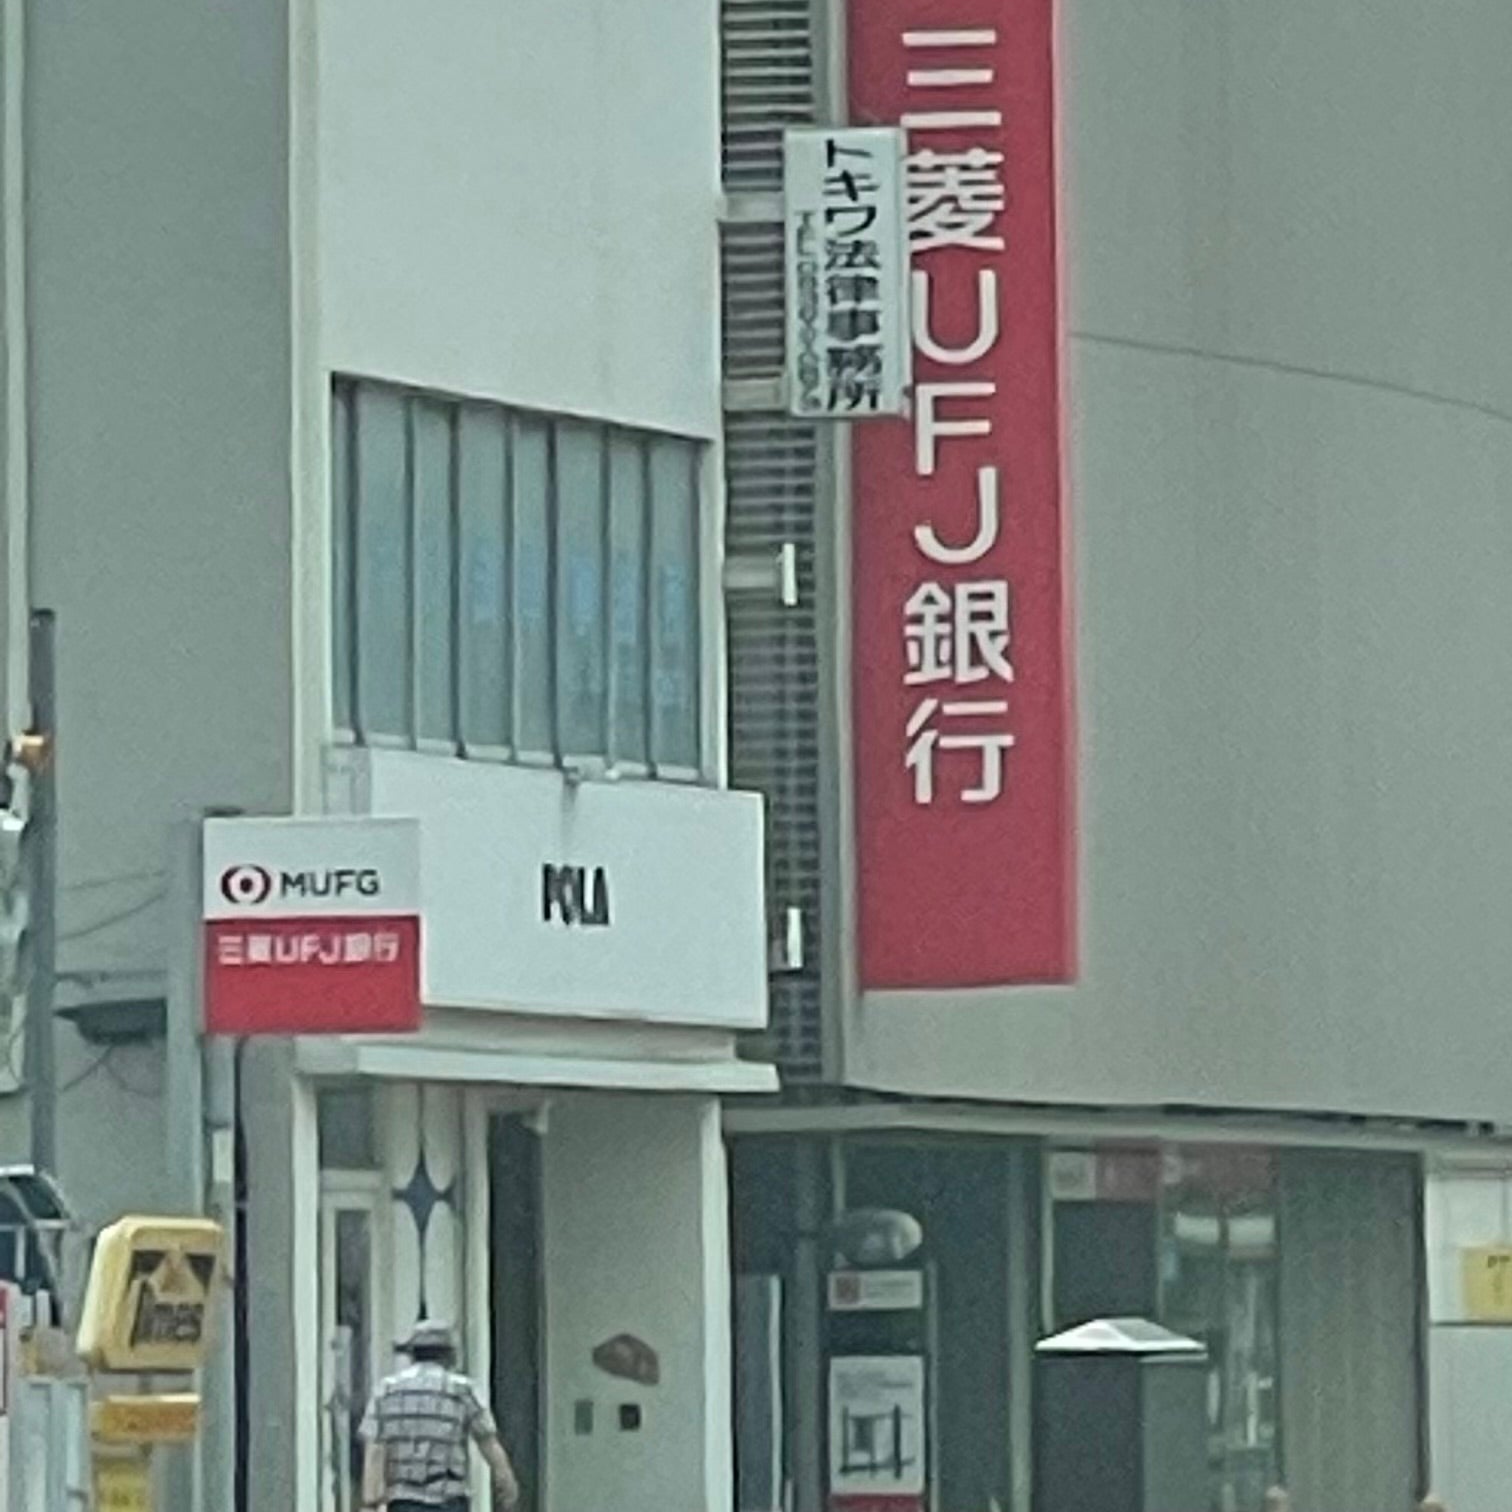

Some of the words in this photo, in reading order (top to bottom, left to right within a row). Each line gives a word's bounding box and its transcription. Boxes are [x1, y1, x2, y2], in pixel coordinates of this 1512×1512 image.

[900, 28, 1014, 804] 三菱UFJ銀行
[280, 869, 381, 898] MUFG
